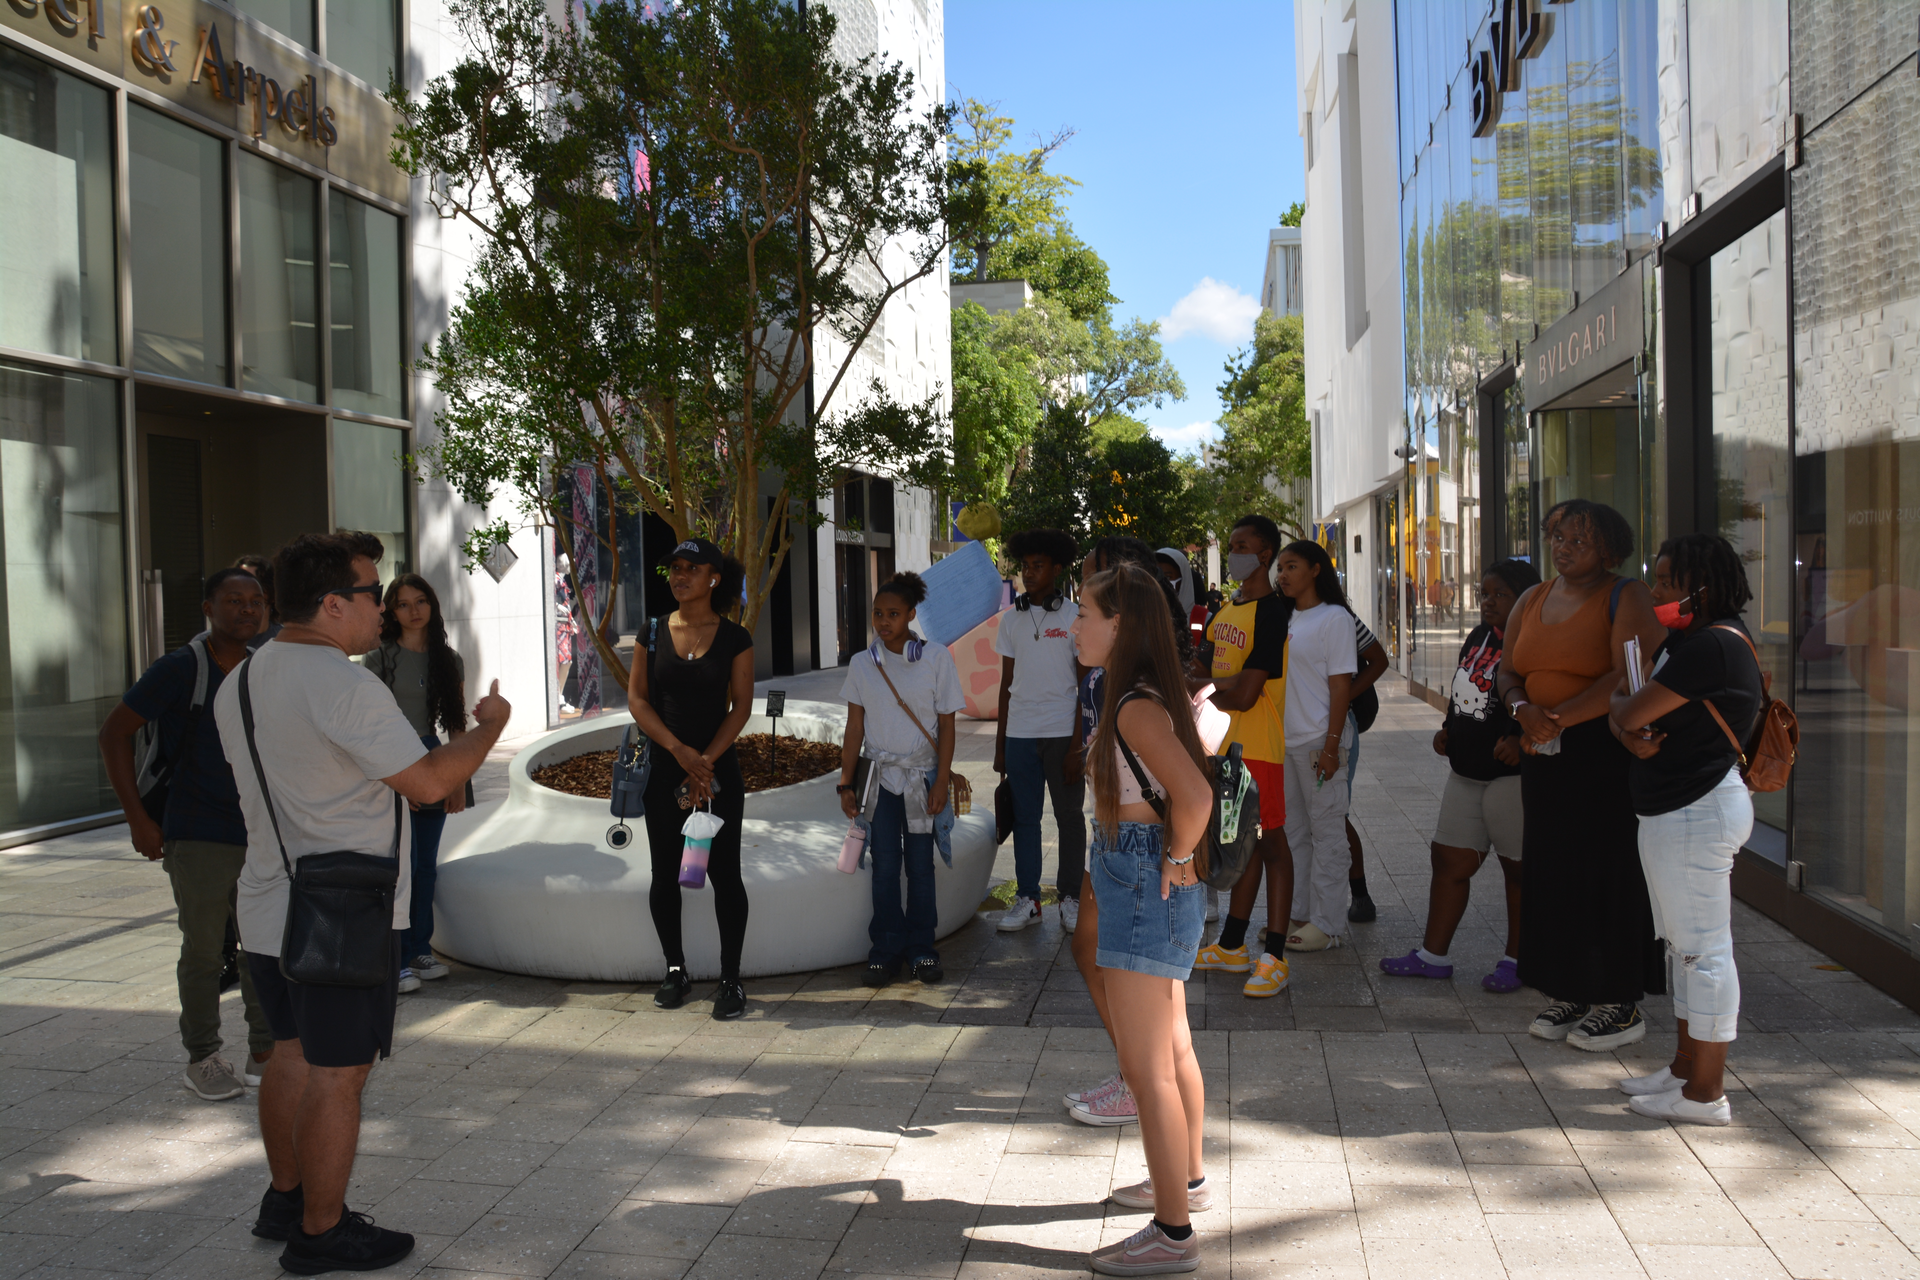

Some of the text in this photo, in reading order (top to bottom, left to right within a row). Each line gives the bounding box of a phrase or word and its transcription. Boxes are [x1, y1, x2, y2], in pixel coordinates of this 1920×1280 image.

[132, 5, 180, 72] &
[191, 21, 338, 146] Arpels
[1539, 305, 1616, 386] BVLGARI
[1213, 622, 1247, 650] HICAGO
